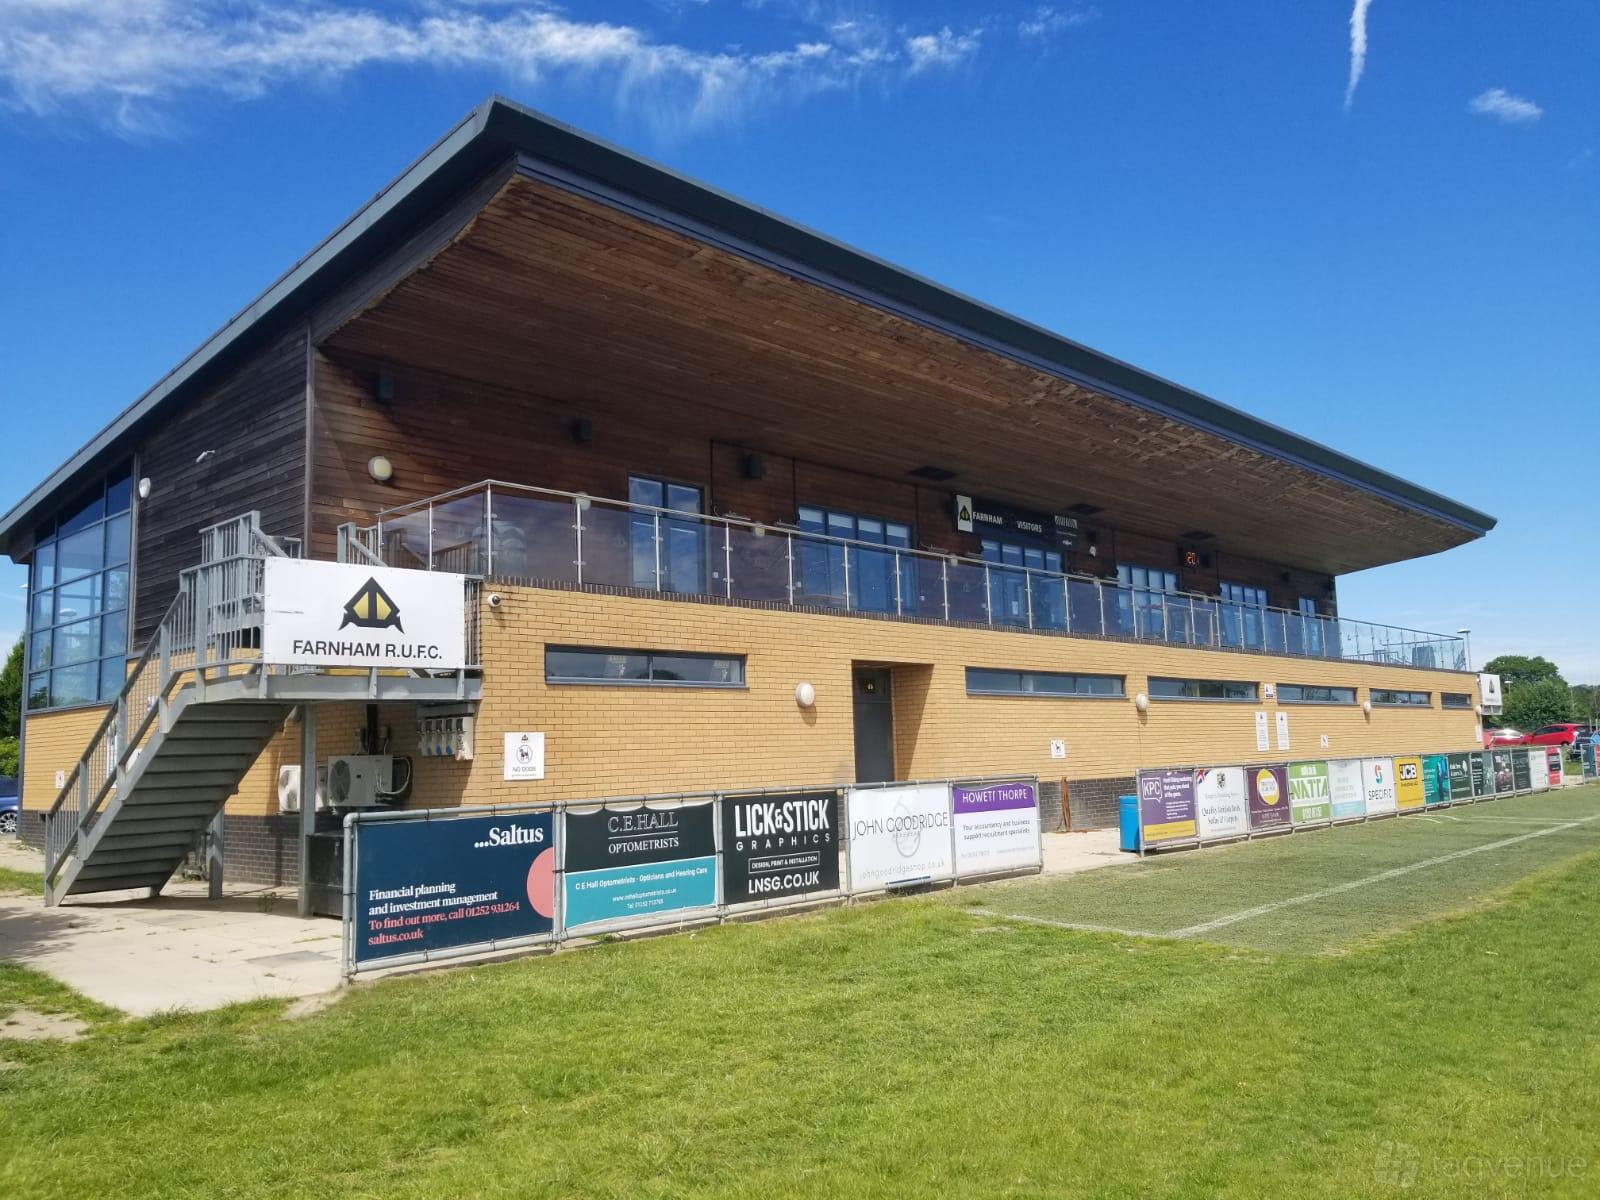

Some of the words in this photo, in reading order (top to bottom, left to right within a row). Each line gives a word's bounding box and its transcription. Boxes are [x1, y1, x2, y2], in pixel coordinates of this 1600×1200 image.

[972, 511, 1003, 525] FARNHAM
[1016, 520, 1042, 533] VISITORS
[293, 639, 380, 657] FARNHAM
[385, 643, 443, 660] R.U.F.C.
[1400, 765, 1416, 779] JCB
[962, 790, 996, 803] HOWETT
[997, 788, 1028, 800] THORPE
[1144, 781, 1160, 796] KPC
[1290, 777, 1328, 800] NATTA
[1368, 788, 1392, 800] SPECIFIC
[607, 812, 679, 833] C.E.HALL
[734, 799, 830, 837] LICK&STICK
[850, 818, 883, 840] JOHN
[886, 811, 948, 833] GOODRIDGE
[608, 837, 679, 854] OPTOMETRISTS
[736, 833, 830, 851] GRAPHICS
[751, 861, 770, 869] DESIGN,
[789, 855, 818, 864] INSTALLATION
[586, 880, 599, 889] Hall
[600, 877, 635, 887] Optometrists
[639, 872, 664, 882] Opticians
[675, 869, 695, 878] Hearing
[748, 870, 819, 894] LNSG.CO.UK
[369, 885, 413, 900] Financial
[415, 882, 456, 897] planning
[369, 902, 388, 916] and
[389, 897, 441, 913] investment
[442, 891, 498, 907] management
[369, 919, 382, 930] To
[384, 916, 404, 927] find
[405, 915, 420, 925] out
[422, 913, 447, 924] more,
[448, 909, 464, 920] call
[465, 907, 490, 916] 01252
[491, 901, 520, 914] 931264
[368, 928, 424, 945] saltus.co.uk
